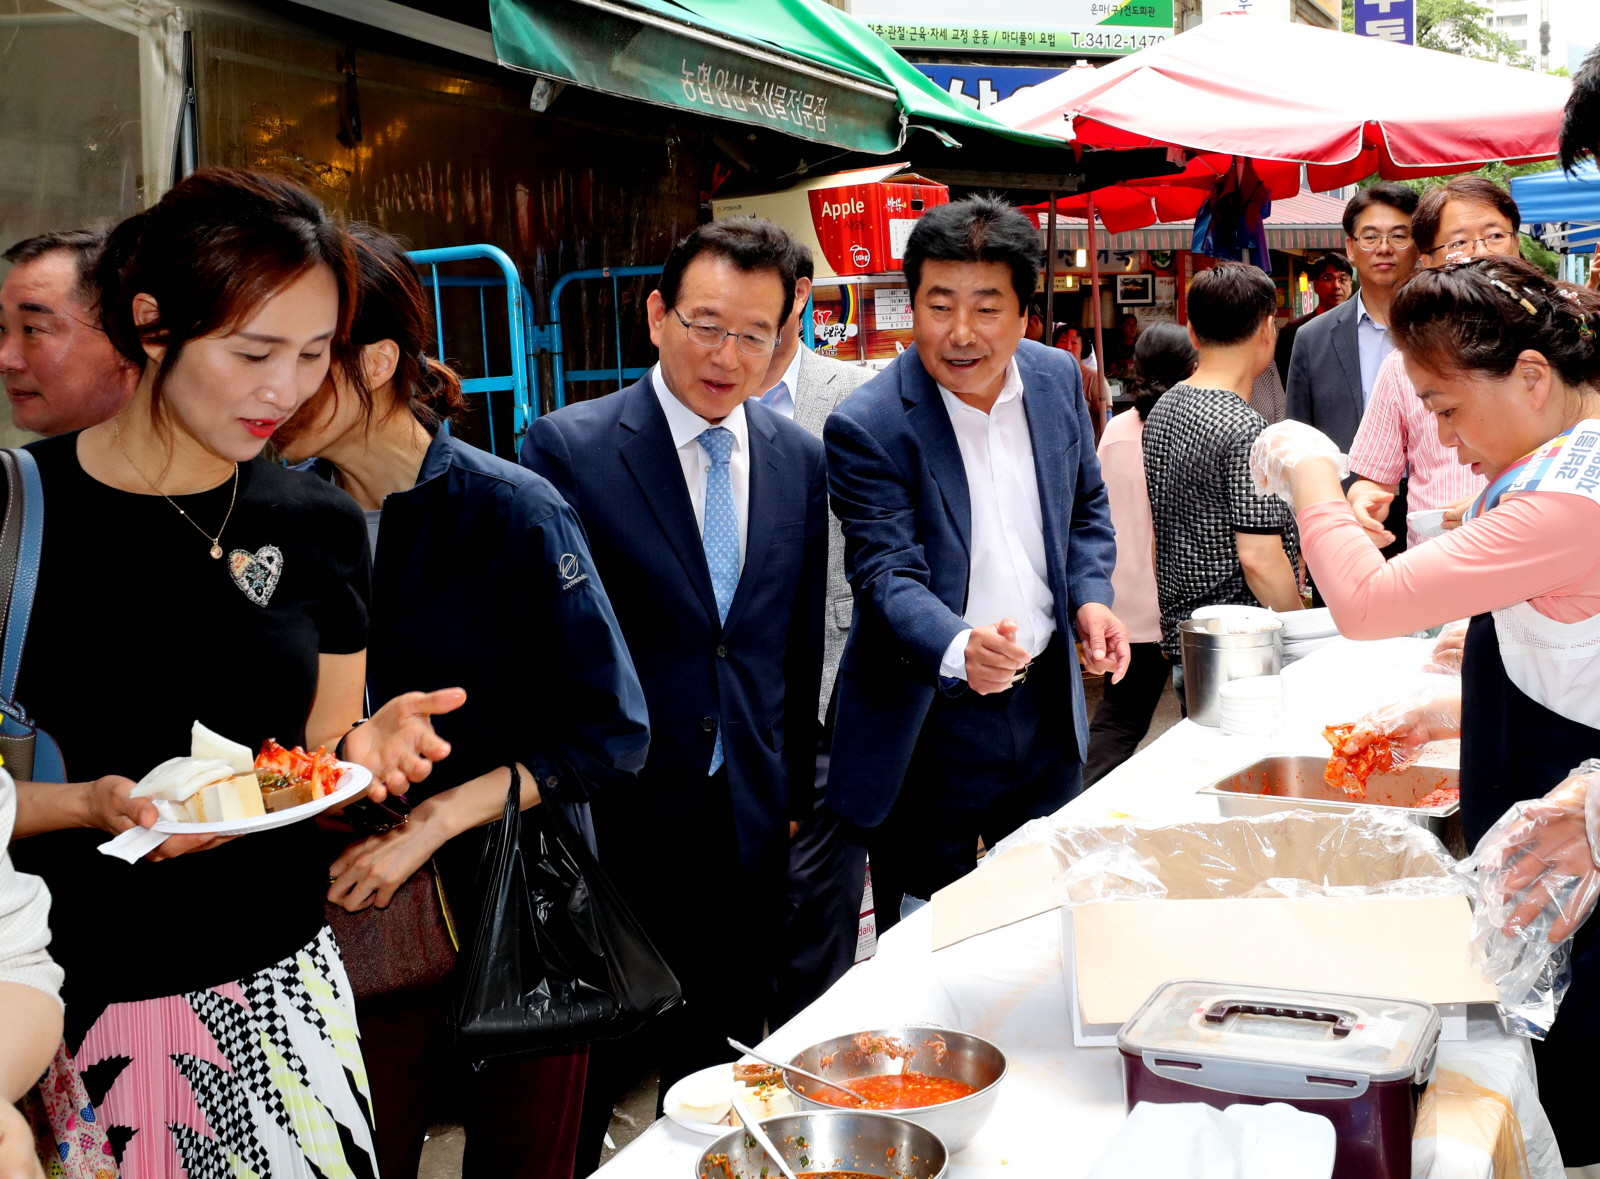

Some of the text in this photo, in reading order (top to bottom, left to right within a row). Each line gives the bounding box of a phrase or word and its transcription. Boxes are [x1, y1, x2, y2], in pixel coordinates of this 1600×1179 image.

[951, 28, 968, 44] 교정
[972, 29, 990, 45] 운동
[1001, 30, 1036, 46] 마디풀이
[1039, 32, 1056, 47] 요법
[821, 197, 865, 220] Apple
[843, 219, 866, 232] 사과
[858, 923, 875, 938] daily
